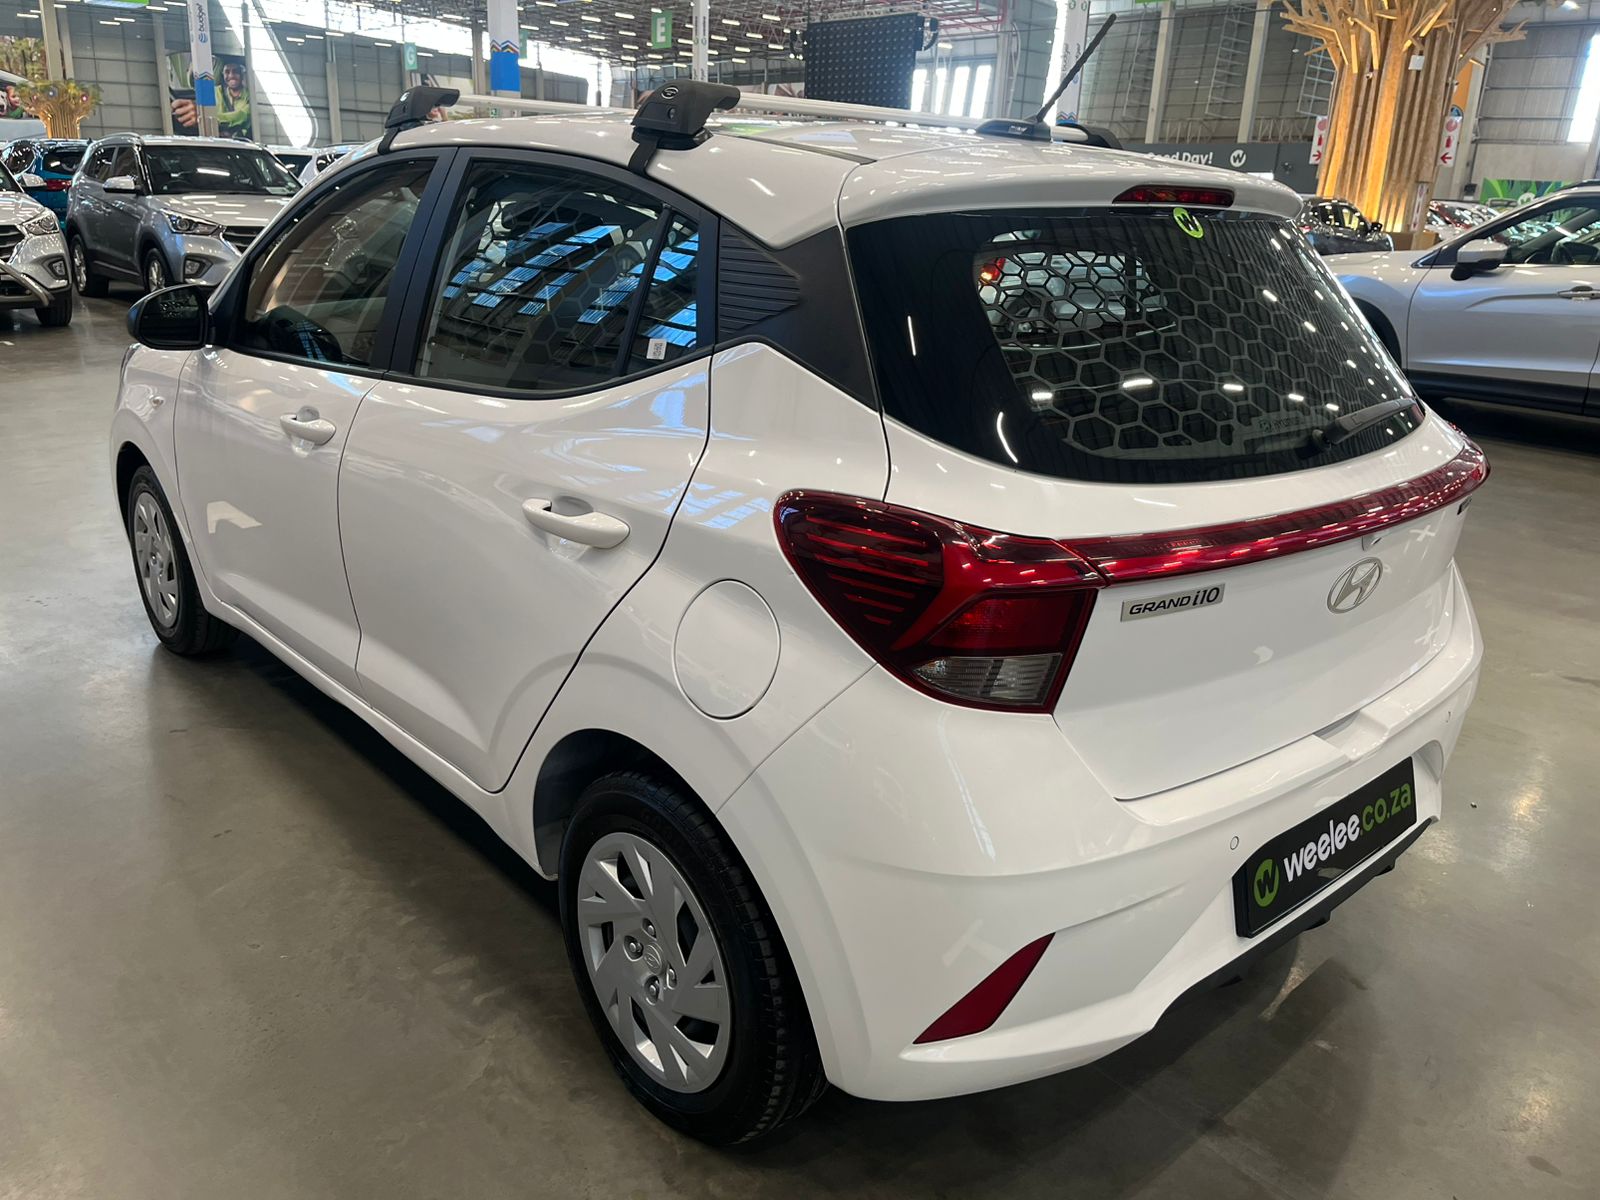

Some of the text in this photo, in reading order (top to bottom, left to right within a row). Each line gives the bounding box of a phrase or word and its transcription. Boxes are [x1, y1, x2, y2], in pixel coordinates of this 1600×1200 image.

[656, 17, 666, 43] E
[406, 46, 415, 65] G
[1129, 587, 1220, 615] GRAND i10
[1283, 783, 1412, 882] weelee.co.za
